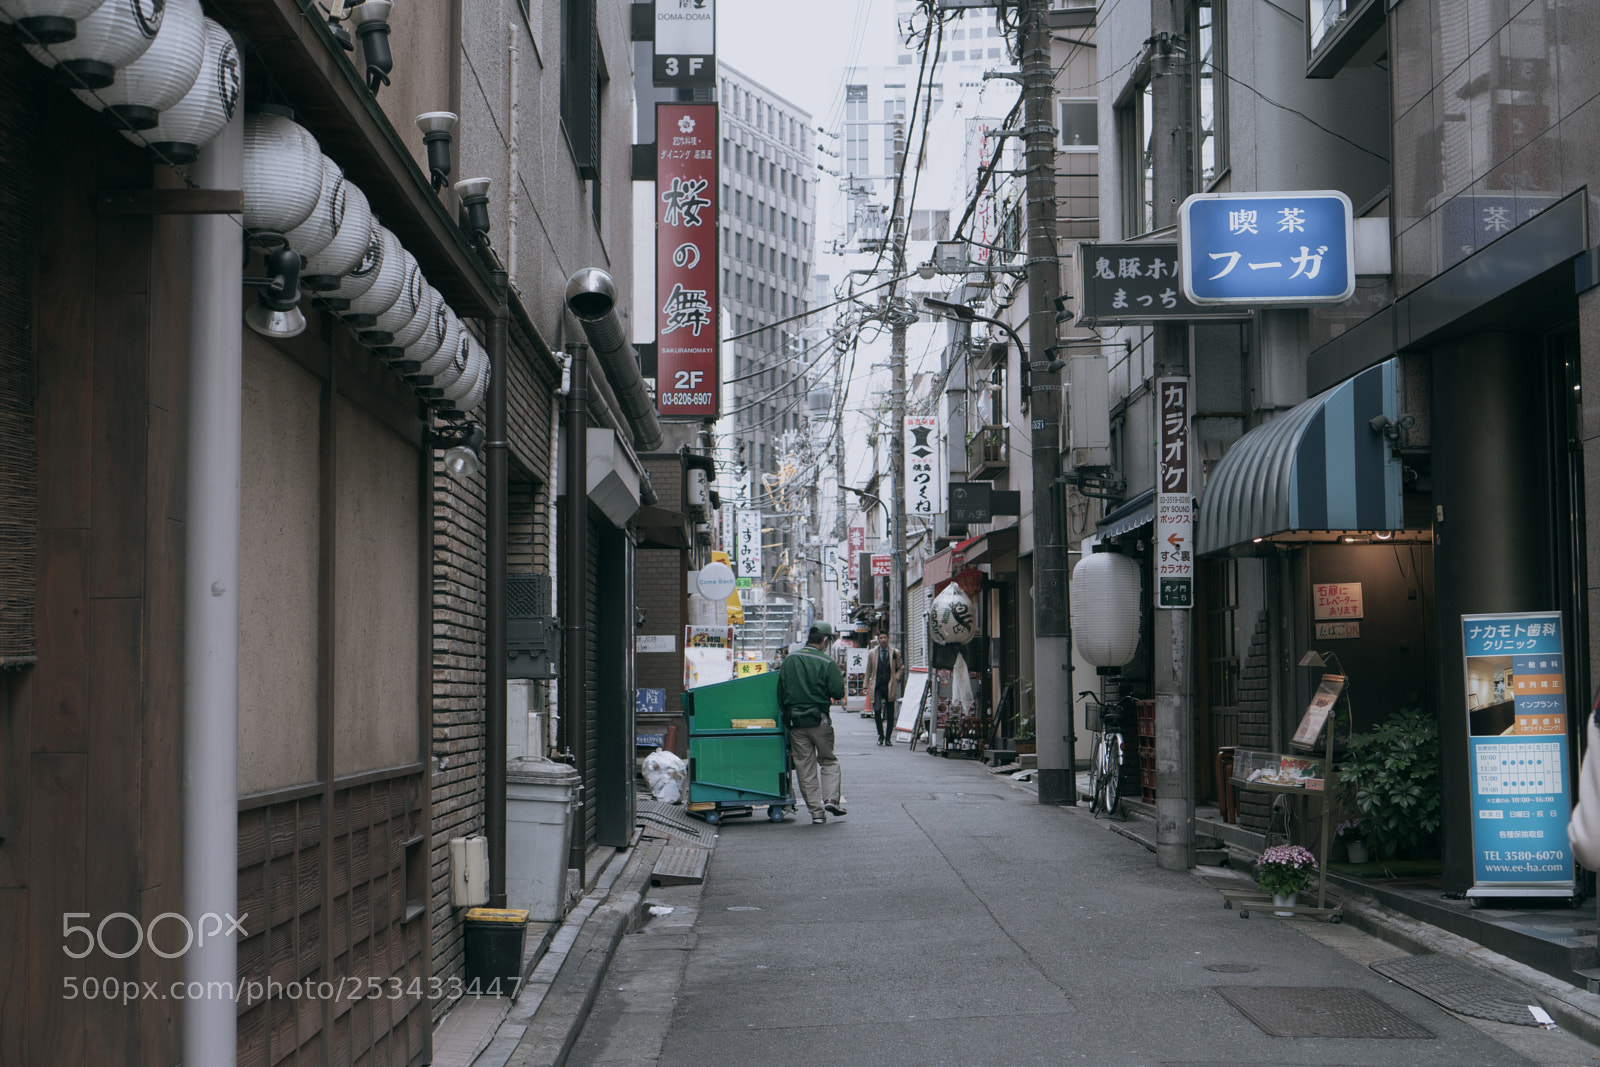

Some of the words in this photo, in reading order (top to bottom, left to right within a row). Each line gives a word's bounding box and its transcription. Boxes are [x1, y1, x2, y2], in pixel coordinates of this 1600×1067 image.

[657, 13, 711, 21] DOMA-DOMA
[660, 149, 692, 160] ダイニング
[1229, 207, 1306, 236] 喫茶
[661, 176, 712, 337] 桜の舞
[1208, 245, 1329, 281] フーガ
[1092, 257, 1179, 281] 鬼豚ホ
[674, 371, 704, 390] 2F
[662, 392, 712, 405] 03-6206-6907
[1164, 385, 1185, 490] カラオケ
[912, 473, 931, 512] つくね
[1171, 505, 1191, 513] SOUND
[1160, 514, 1191, 524] ボックス
[1160, 551, 1191, 562] すぐ裏
[1160, 564, 1191, 574] カラオケ
[1164, 585, 1187, 593] 虎ノ門
[1317, 585, 1348, 597] 右扉に
[1318, 596, 1358, 606] エレベーター
[1329, 605, 1358, 616] あります
[1470, 622, 1556, 640] ナカモト歯科
[1483, 639, 1537, 651] クリニック
[1517, 660, 1558, 669] 一般歯科
[1518, 680, 1559, 689] 歯列矯正
[1519, 701, 1560, 709] インプラント
[1484, 851, 1502, 861] TEL
[1504, 850, 1563, 861] 3580-6070
[1485, 862, 1563, 872] www.ee-ha.com
